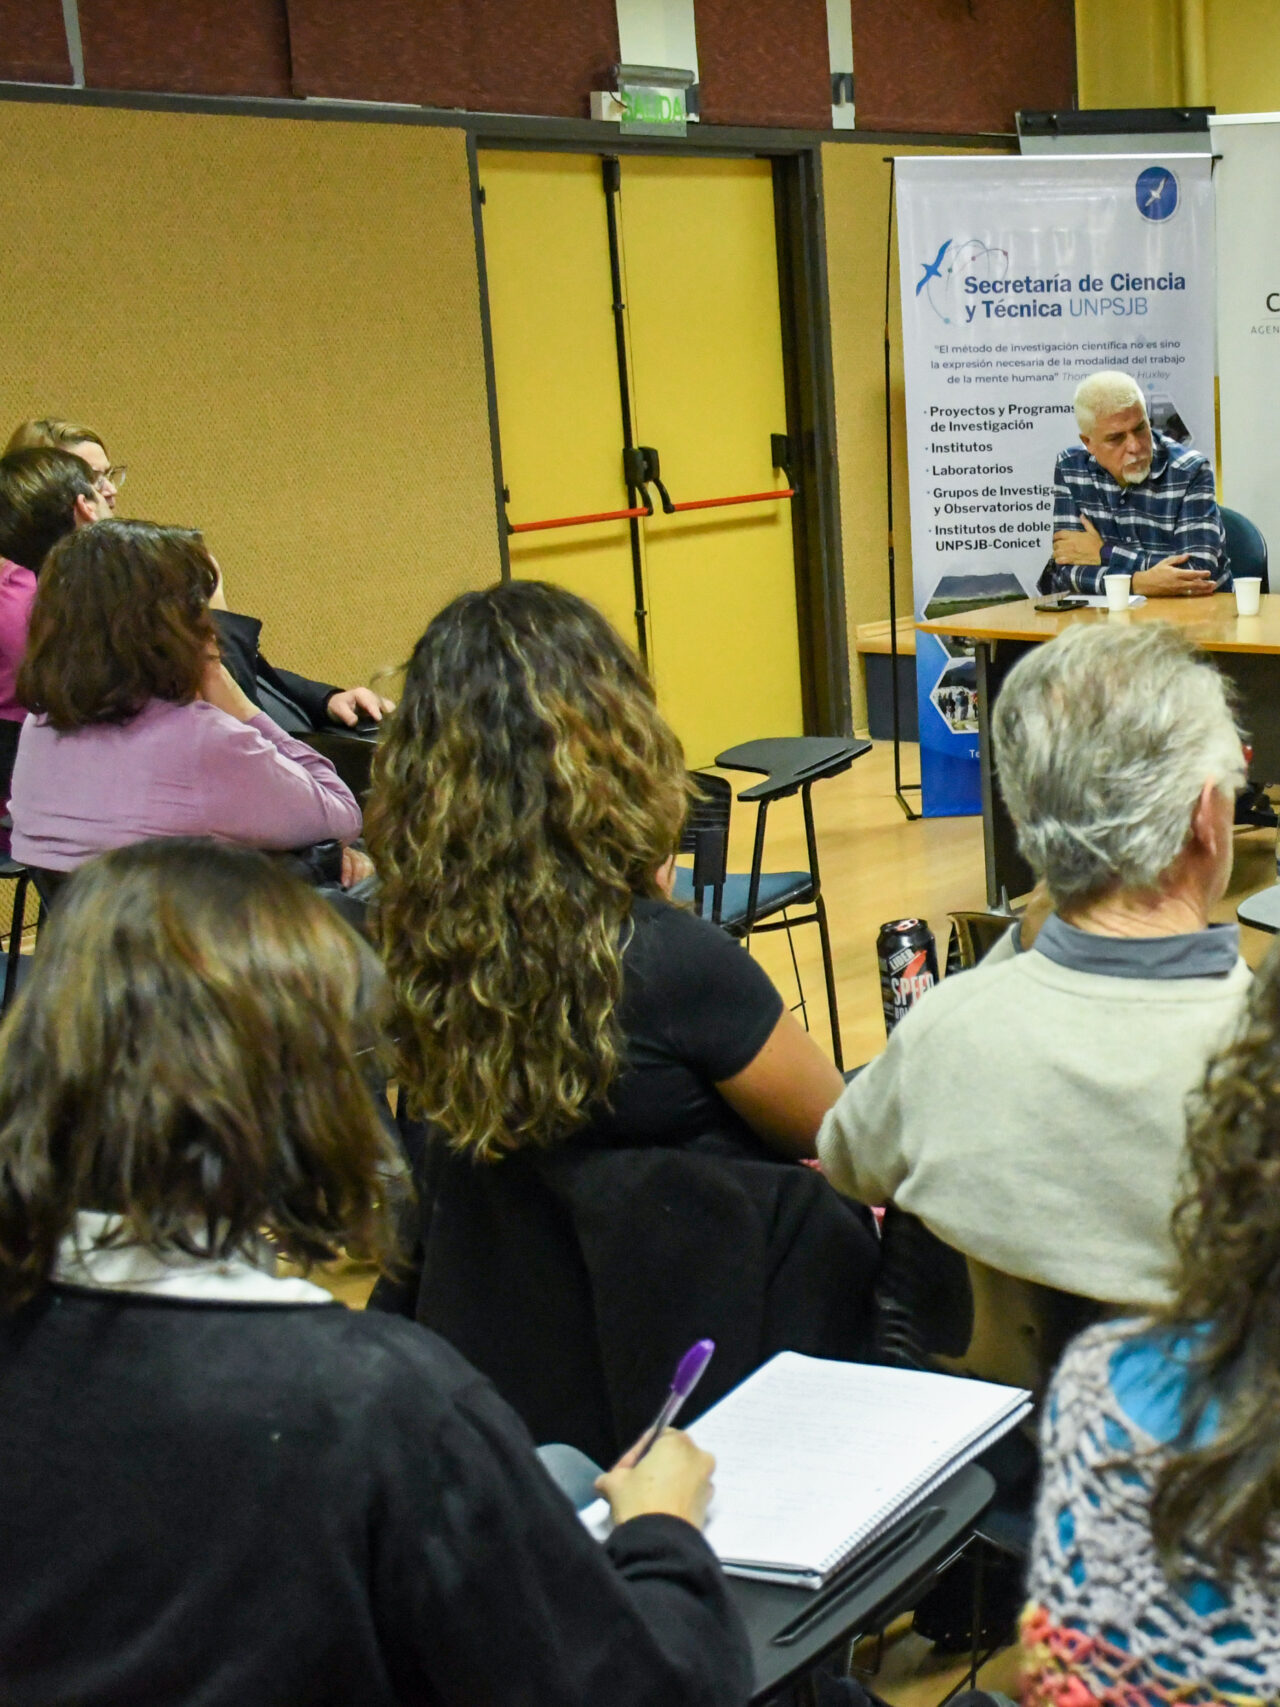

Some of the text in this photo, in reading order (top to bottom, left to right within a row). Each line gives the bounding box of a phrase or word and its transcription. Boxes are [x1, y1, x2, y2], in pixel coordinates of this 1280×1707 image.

[621, 91, 683, 122] SALIDA
[964, 272, 1186, 295] Secretaría de Ciencia
[965, 297, 1148, 323] y Técnica UNPSJB
[951, 343, 992, 354] método
[995, 343, 1008, 353] de
[1011, 341, 1079, 353] investigación
[1081, 341, 1128, 351] científica
[1130, 342, 1143, 350] no
[1146, 341, 1157, 350] es
[1160, 340, 1181, 349] sino
[931, 354, 1185, 370] la expresión necesaria de la modalidad del trabajo
[947, 375, 961, 384] de
[963, 375, 972, 384] la
[975, 374, 1009, 383] mente
[1137, 369, 1171, 381] Huxley
[930, 405, 996, 418] Proyectos
[997, 407, 1005, 417] y
[930, 419, 1034, 433] de Investigación
[931, 442, 993, 453] Institutos
[932, 463, 1014, 476] Laboratorios
[933, 487, 979, 499] Grupos
[981, 486, 997, 497] de
[934, 500, 1051, 516] y Observatorios de
[935, 521, 1051, 535] Institutos de doble
[935, 538, 1041, 551] UNPSJB-Conicet
